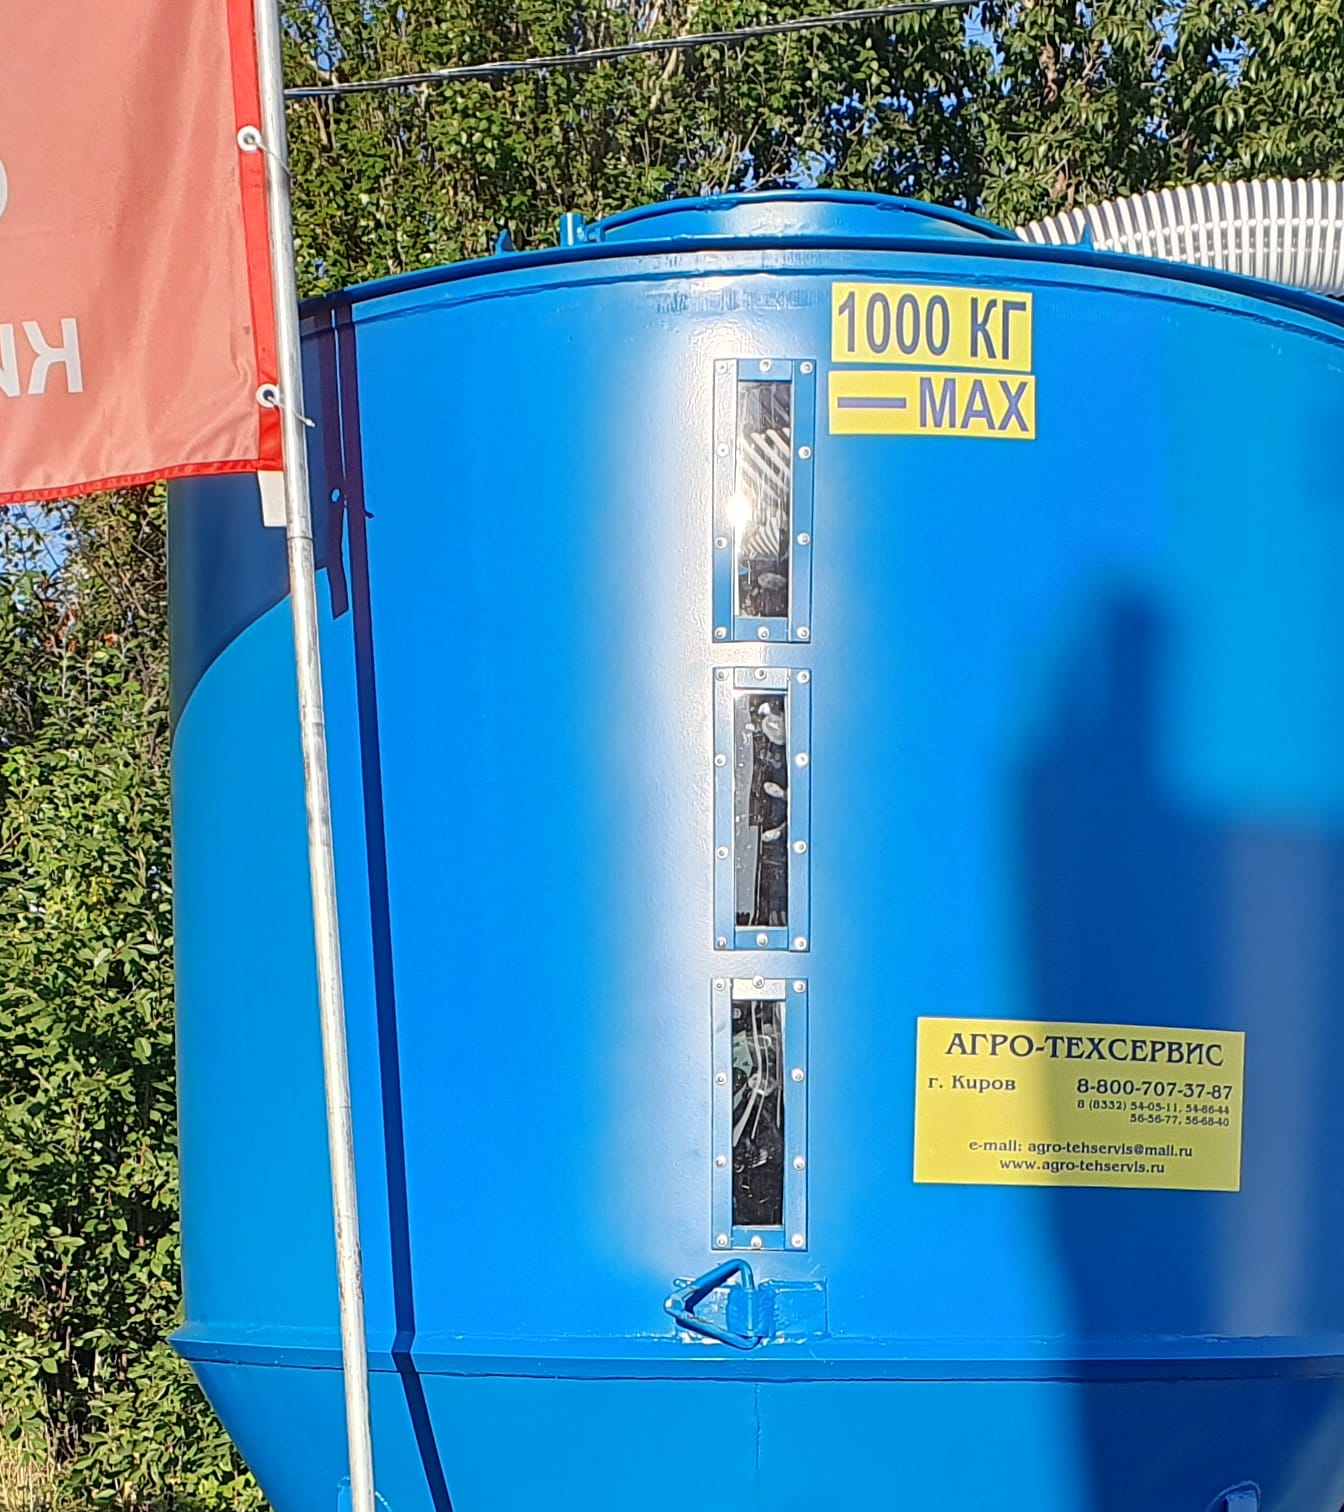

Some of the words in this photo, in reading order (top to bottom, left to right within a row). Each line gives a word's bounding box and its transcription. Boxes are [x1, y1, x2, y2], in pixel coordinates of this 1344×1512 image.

[838, 291, 950, 356] 1000
[970, 297, 1027, 360] КГ
[919, 377, 1029, 432] MAX
[945, 1033, 1224, 1066] АГРО-ТЕХСЕРВИС
[928, 1078, 944, 1089] г.
[951, 1075, 1016, 1093] Киров
[1077, 1079, 1233, 1100] 8-800-707-37-87
[1077, 1099, 1085, 1109] 8
[1089, 1099, 1127, 1111] (8332)
[969, 1140, 1022, 1151] e-mail:
[1028, 1141, 1193, 1157] agro-tehservis@mail.ru
[1000, 1158, 1165, 1173] www.agro-tehservis.ru
